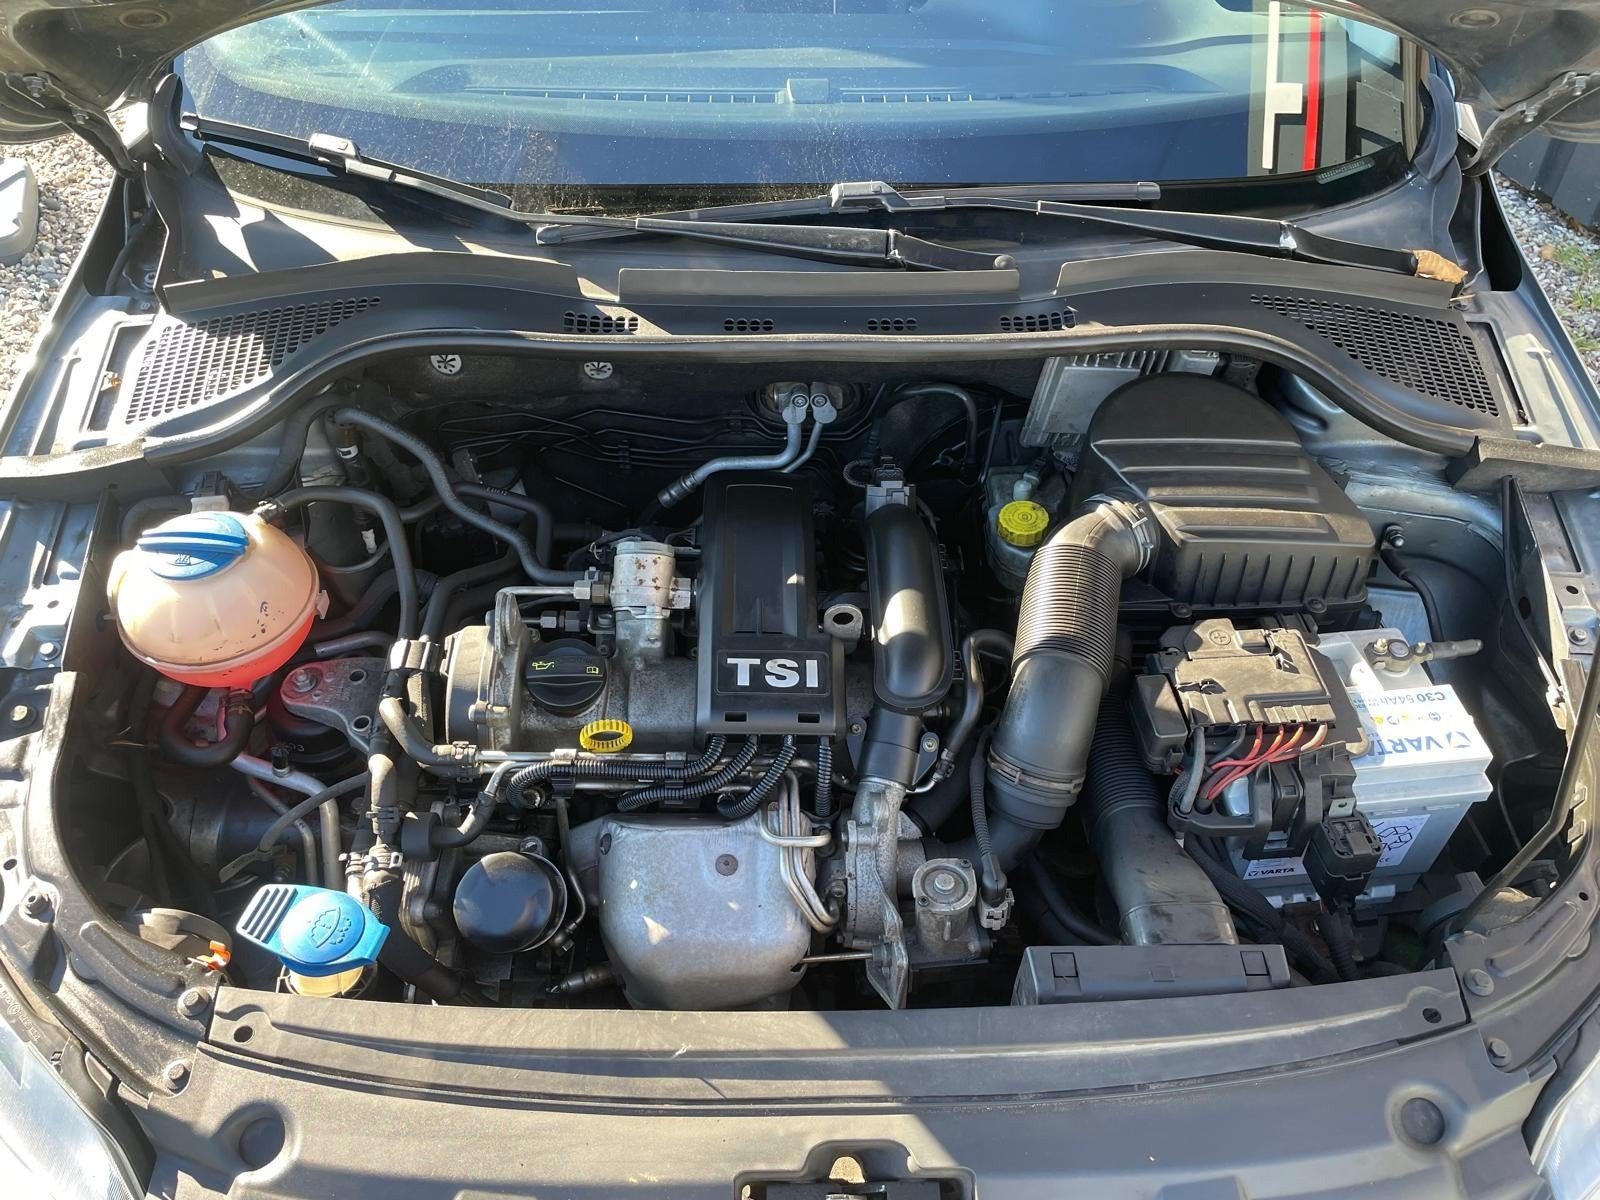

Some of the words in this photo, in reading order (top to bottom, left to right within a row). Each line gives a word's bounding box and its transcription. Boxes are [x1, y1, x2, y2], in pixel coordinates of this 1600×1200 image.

[726, 657, 819, 688] TSI
[1380, 694, 1415, 706] 54Ah
[1416, 691, 1446, 703] C30
[1260, 867, 1295, 875] VARTA
